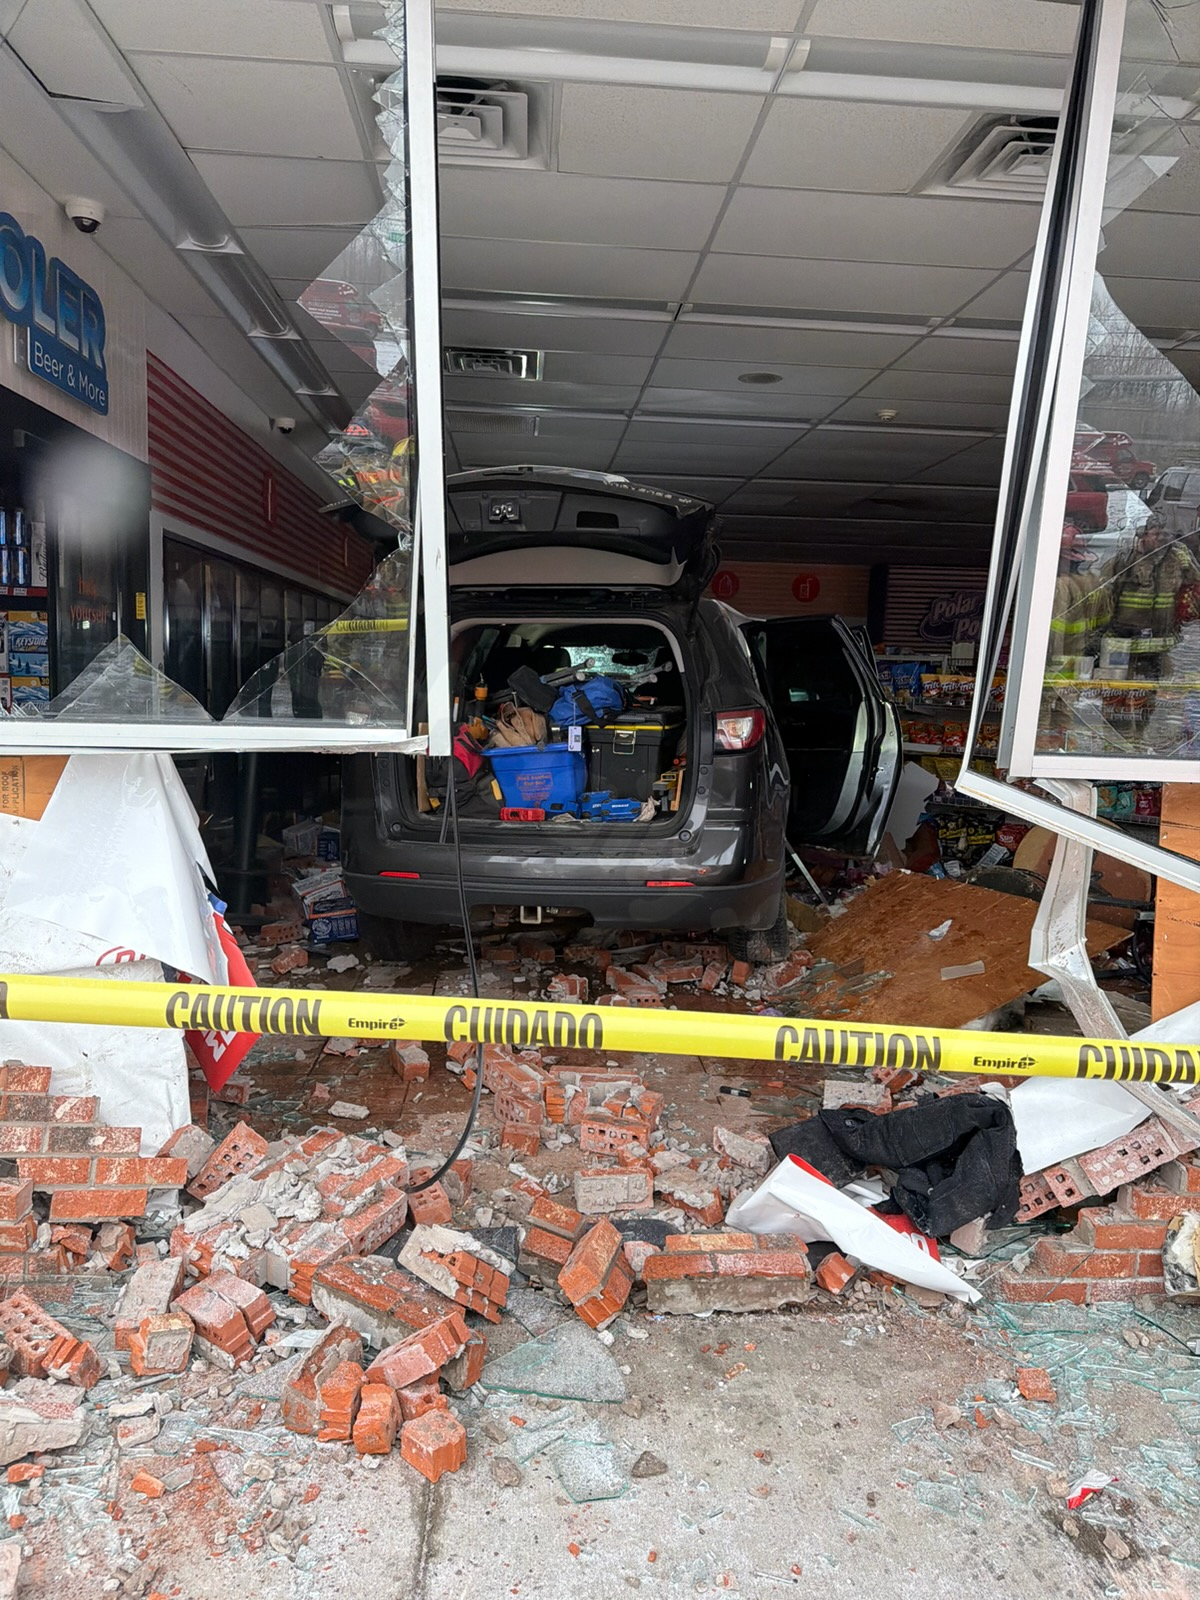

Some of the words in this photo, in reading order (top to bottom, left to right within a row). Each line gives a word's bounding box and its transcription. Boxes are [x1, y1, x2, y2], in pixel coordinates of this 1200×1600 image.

[35, 341, 63, 380] Beer
[67, 364, 75, 387] &
[79, 371, 105, 406] More
[933, 594, 977, 621] Polar
[955, 616, 980, 641] Po
[15, 637, 48, 648] KEYSTONE
[1, 770, 9, 792] ROOF
[166, 991, 323, 1037] CAUTION
[347, 1016, 396, 1031] Empire
[444, 1004, 604, 1050] CUIDADO
[775, 1025, 941, 1071] CAUTION
[973, 1056, 1028, 1070] Empire
